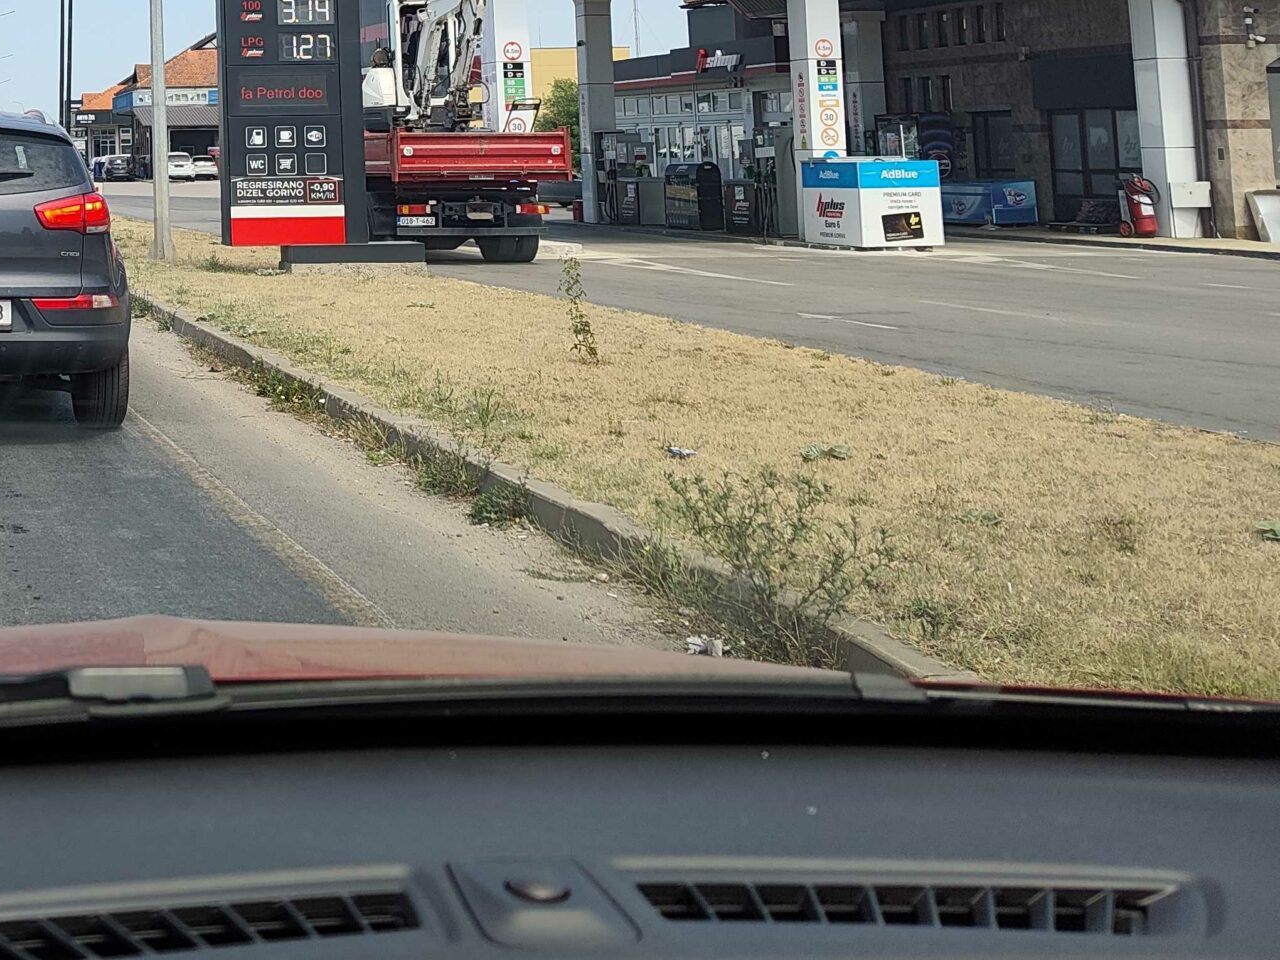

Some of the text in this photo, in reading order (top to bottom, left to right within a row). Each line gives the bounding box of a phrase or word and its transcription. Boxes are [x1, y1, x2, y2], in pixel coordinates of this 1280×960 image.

[242, 1, 261, 10] 100
[241, 37, 264, 46] LPG
[292, 34, 331, 59] 1.27
[257, 86, 296, 100] Petrol
[298, 87, 323, 99] doo
[249, 159, 264, 169] WC
[880, 169, 918, 179] AdBlue
[236, 181, 304, 189] REGRESIRANO
[310, 183, 334, 192] -0,90
[236, 189, 304, 197] DIZEL GORIVO
[311, 191, 335, 200] KM/lit
